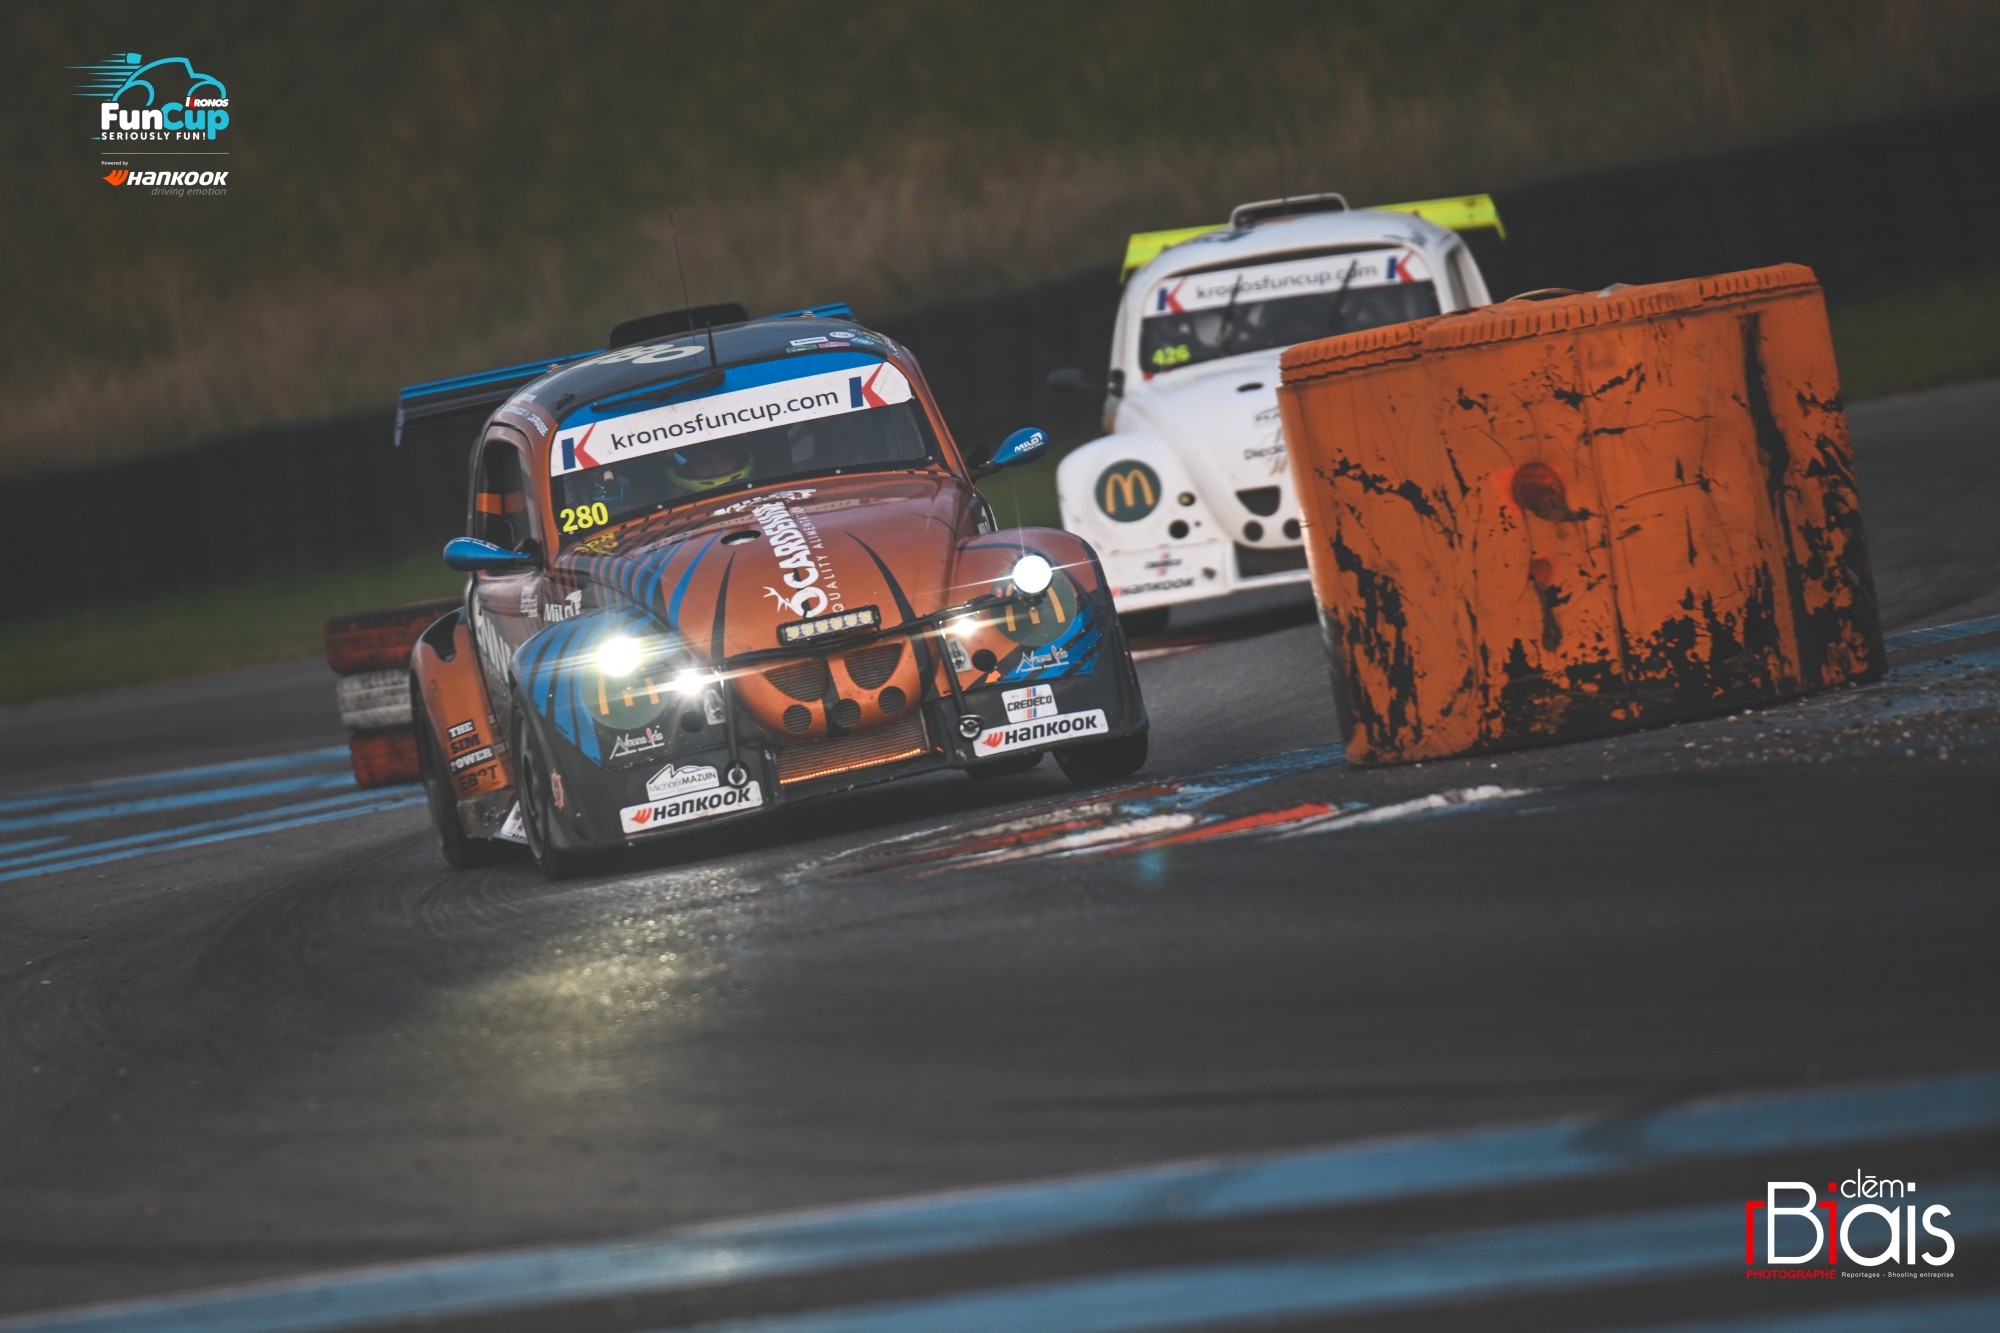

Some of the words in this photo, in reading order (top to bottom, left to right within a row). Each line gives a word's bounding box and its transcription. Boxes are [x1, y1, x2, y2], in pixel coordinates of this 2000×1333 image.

[1196, 264, 1378, 300] kroosfuncup.cm
[611, 390, 839, 450] kronosfuncup.com
[560, 502, 609, 532] 280
[816, 554, 845, 613] QUALITY
[1006, 694, 1053, 712] CREDECO
[448, 720, 474, 738] THE
[450, 732, 482, 755] SIM
